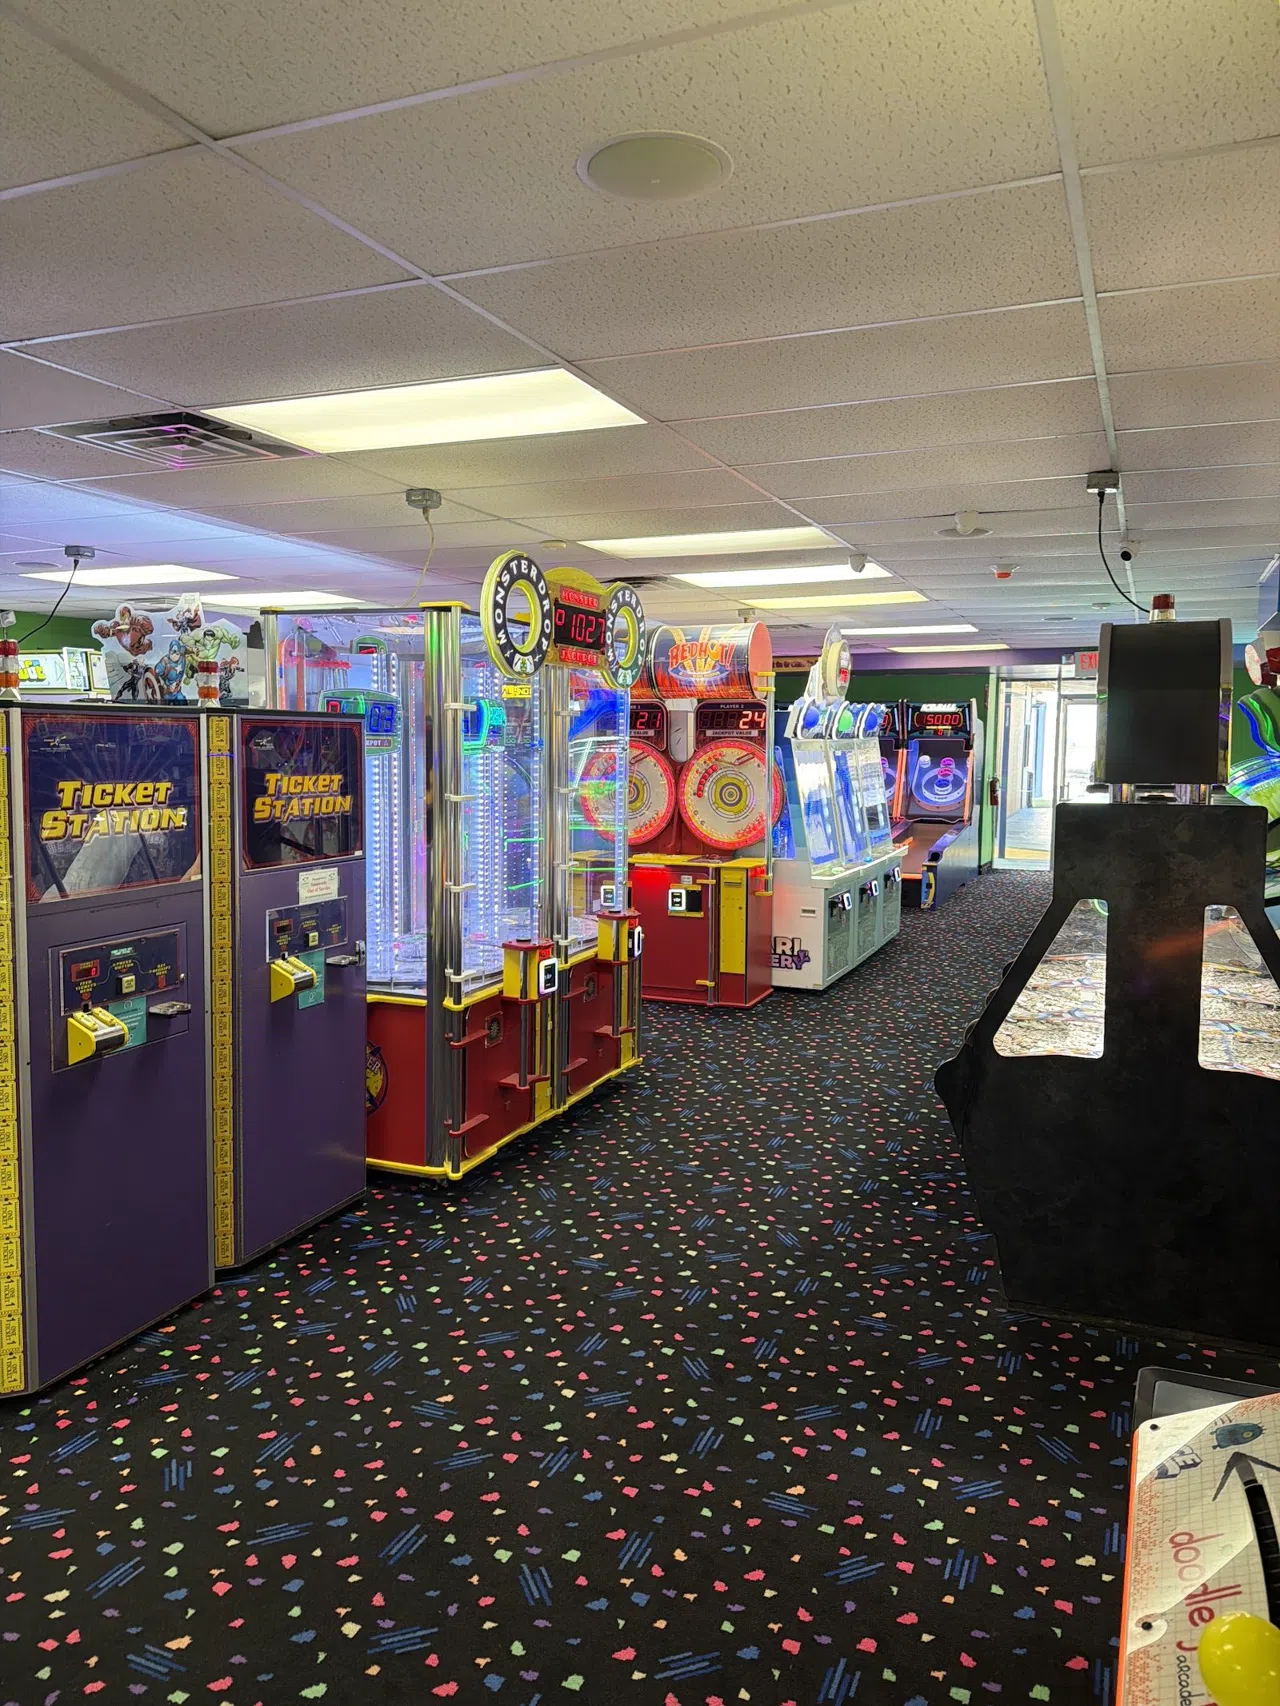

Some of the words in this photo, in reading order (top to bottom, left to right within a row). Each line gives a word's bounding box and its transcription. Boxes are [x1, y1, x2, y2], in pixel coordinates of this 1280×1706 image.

[562, 590, 598, 608] MONSTER
[571, 614, 605, 644] 1027
[561, 648, 597, 665] JACKPOT
[636, 712, 661, 728] 21
[739, 711, 766, 728] 24
[254, 796, 353, 824] STATION
[41, 808, 187, 842] STATION
